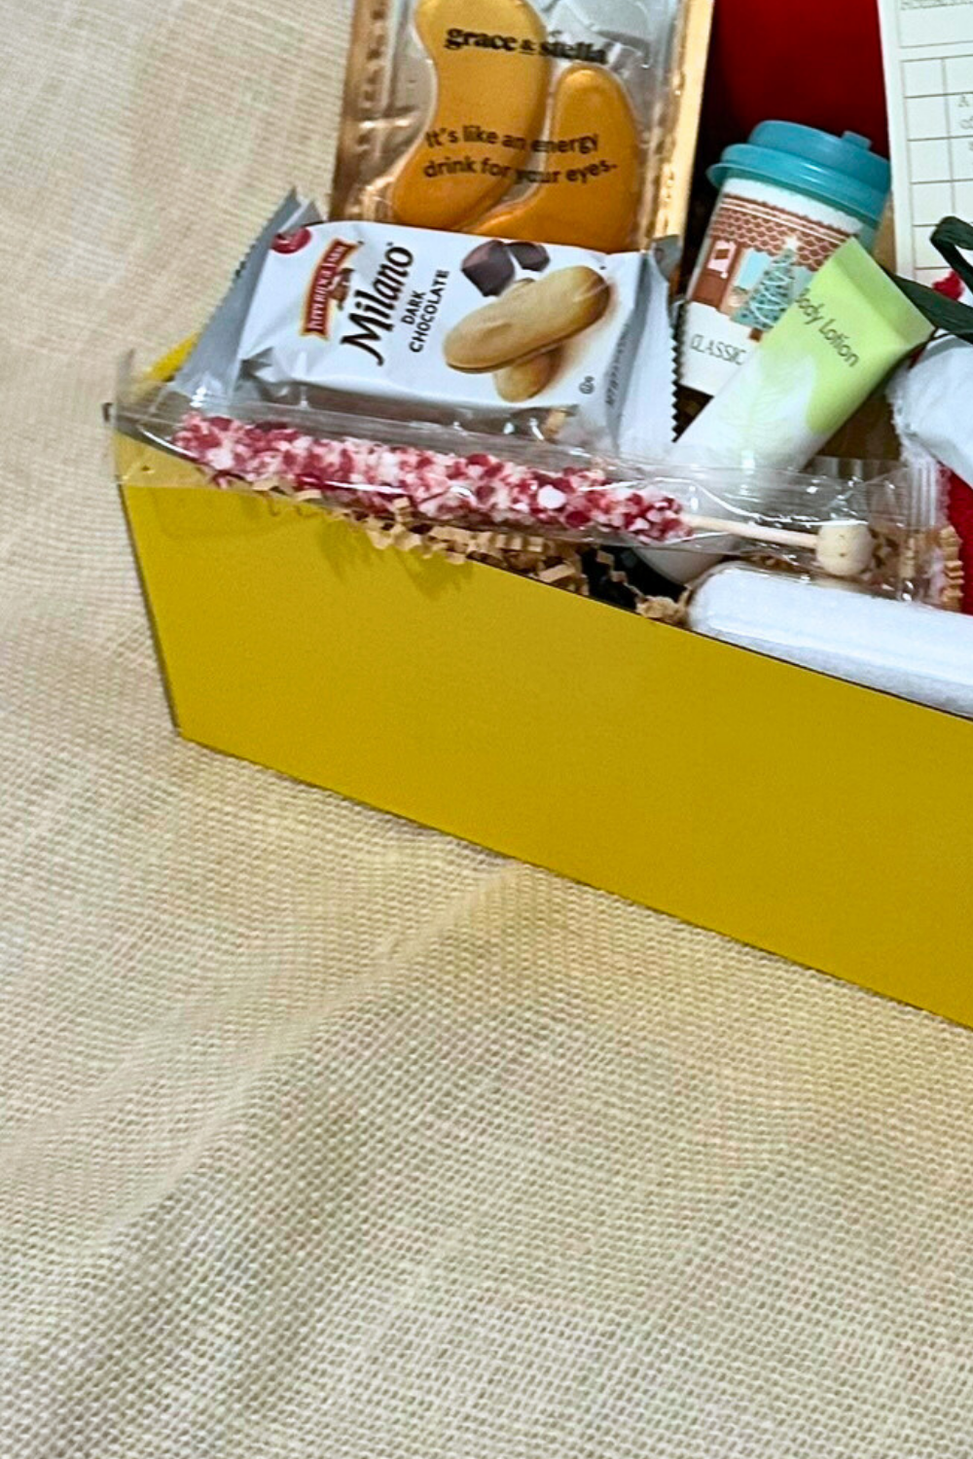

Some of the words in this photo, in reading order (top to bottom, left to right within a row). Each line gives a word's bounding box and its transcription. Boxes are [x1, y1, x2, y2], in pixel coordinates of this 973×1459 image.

[443, 27, 518, 52] grace
[425, 127, 459, 148] It's
[462, 124, 499, 144] like
[501, 134, 527, 151] an
[530, 133, 599, 154] energy
[423, 155, 477, 178] drink
[480, 156, 512, 178] for
[513, 168, 561, 184] your
[565, 159, 619, 184] eyes.
[339, 245, 414, 367] Milano
[400, 290, 427, 326] DARK
[408, 268, 451, 354] CHOCOLATE
[688, 333, 748, 367] CLASSIC
[817, 317, 861, 368] Lotion
